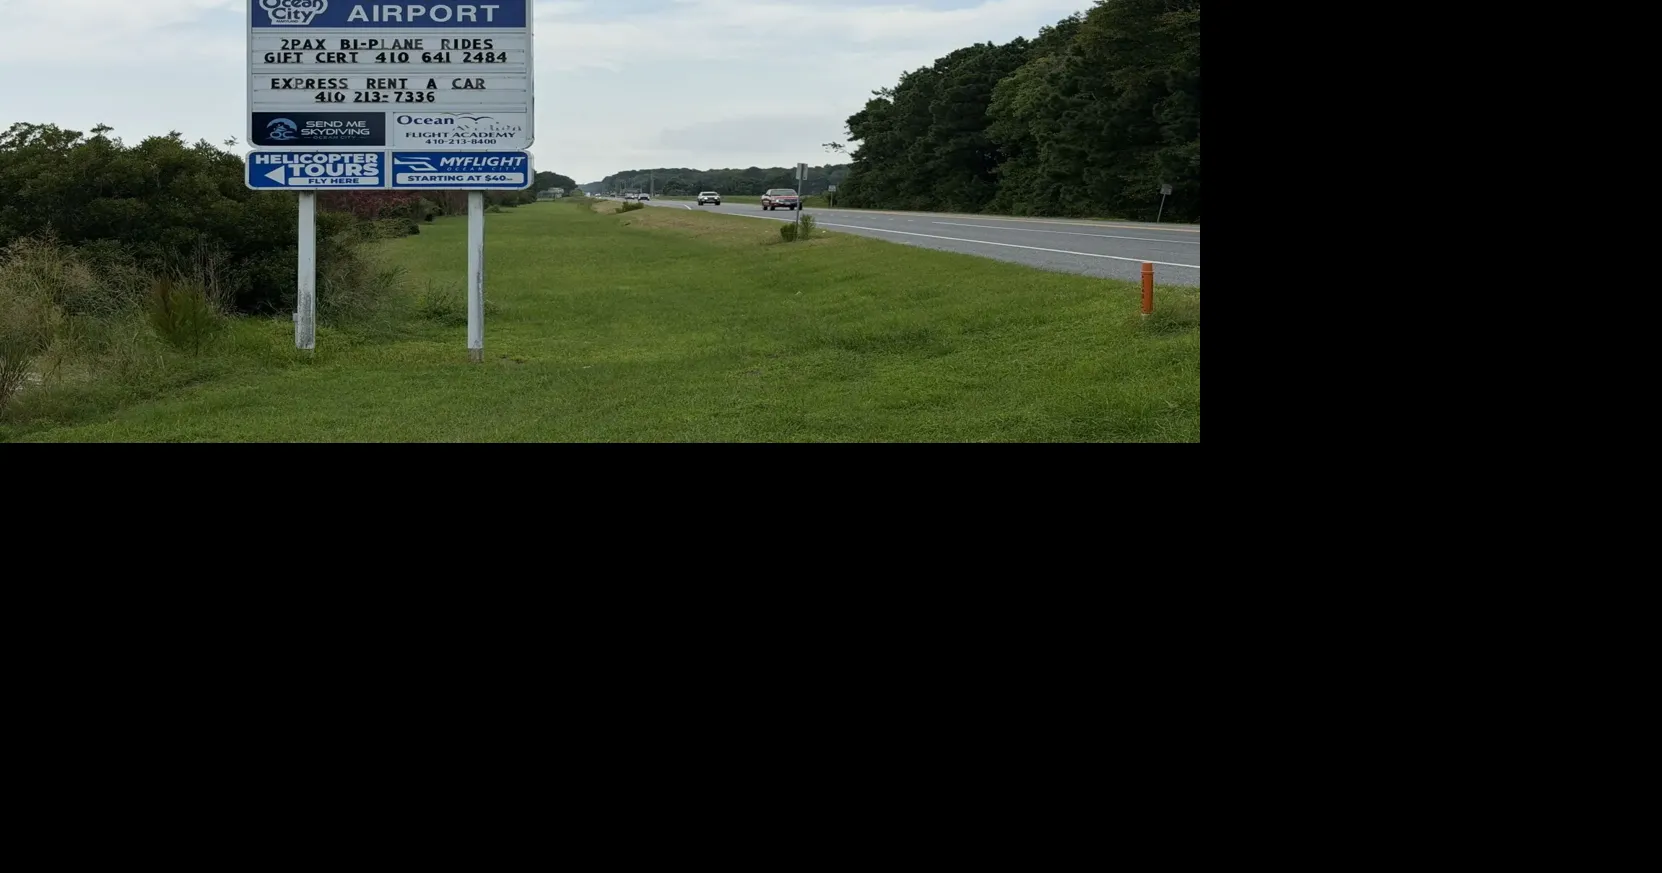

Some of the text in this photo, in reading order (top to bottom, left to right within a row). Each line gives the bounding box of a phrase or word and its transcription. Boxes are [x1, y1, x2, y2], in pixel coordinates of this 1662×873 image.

[271, 7, 314, 23] City
[347, 4, 500, 22] AIRPORT
[280, 38, 494, 50] 2PAX BI-PLANE RIDES
[263, 51, 508, 63] GIFT CERT 410 641 2484
[270, 77, 487, 90] EXPRESS RENT A CAR
[314, 91, 346, 103] 410
[305, 120, 367, 128] SEND ME
[396, 114, 455, 125] Ocean
[300, 128, 370, 136] SKYDIVING
[255, 153, 379, 164] HELICOPTER
[439, 156, 526, 167] MYFLIGHT
[287, 163, 380, 177] TOURS
[407, 174, 464, 182] STARTING
[464, 174, 483, 182] AT
